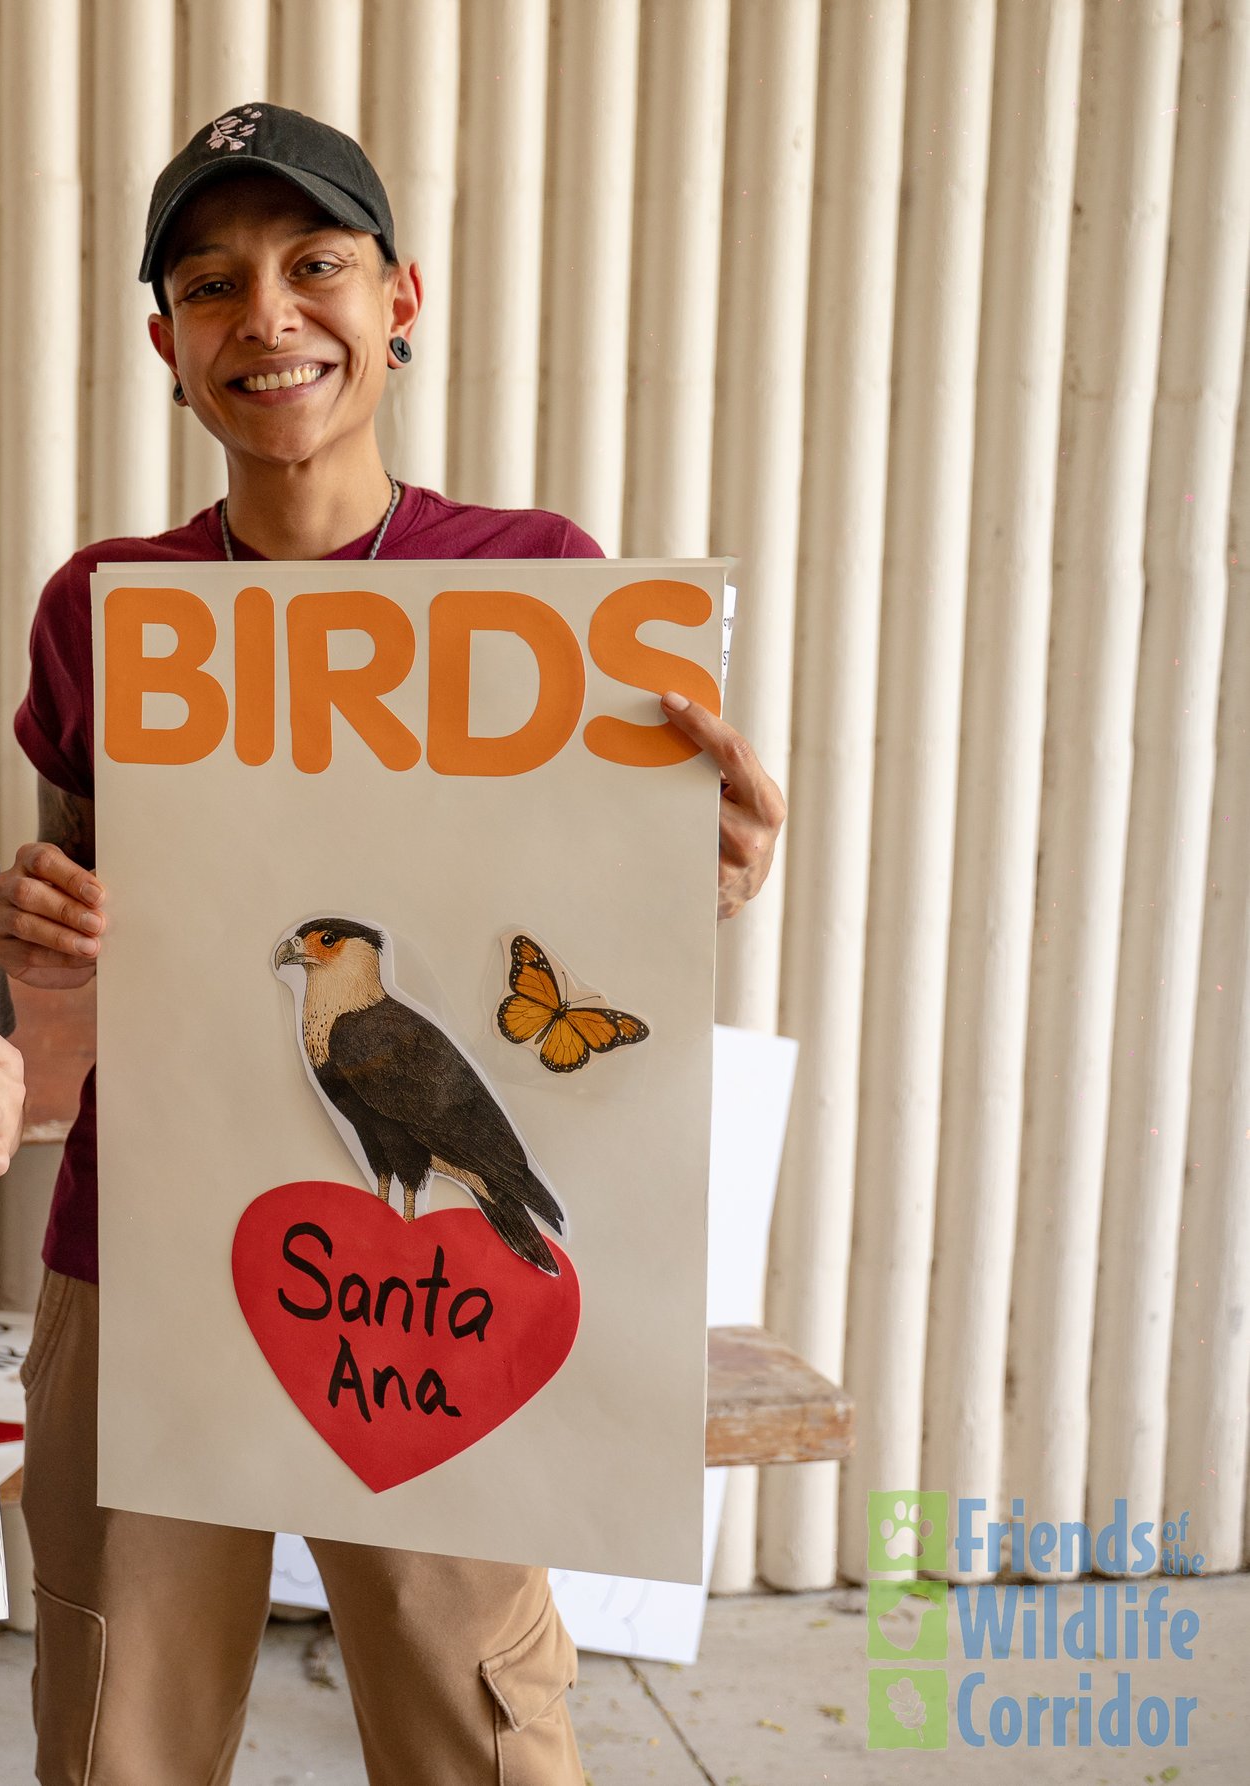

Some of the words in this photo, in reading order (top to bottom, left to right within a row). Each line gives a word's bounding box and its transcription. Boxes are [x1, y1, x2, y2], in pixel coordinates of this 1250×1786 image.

[103, 579, 723, 777] BIRDS
[277, 1221, 494, 1343] Santa
[327, 1333, 462, 1424] Ana
